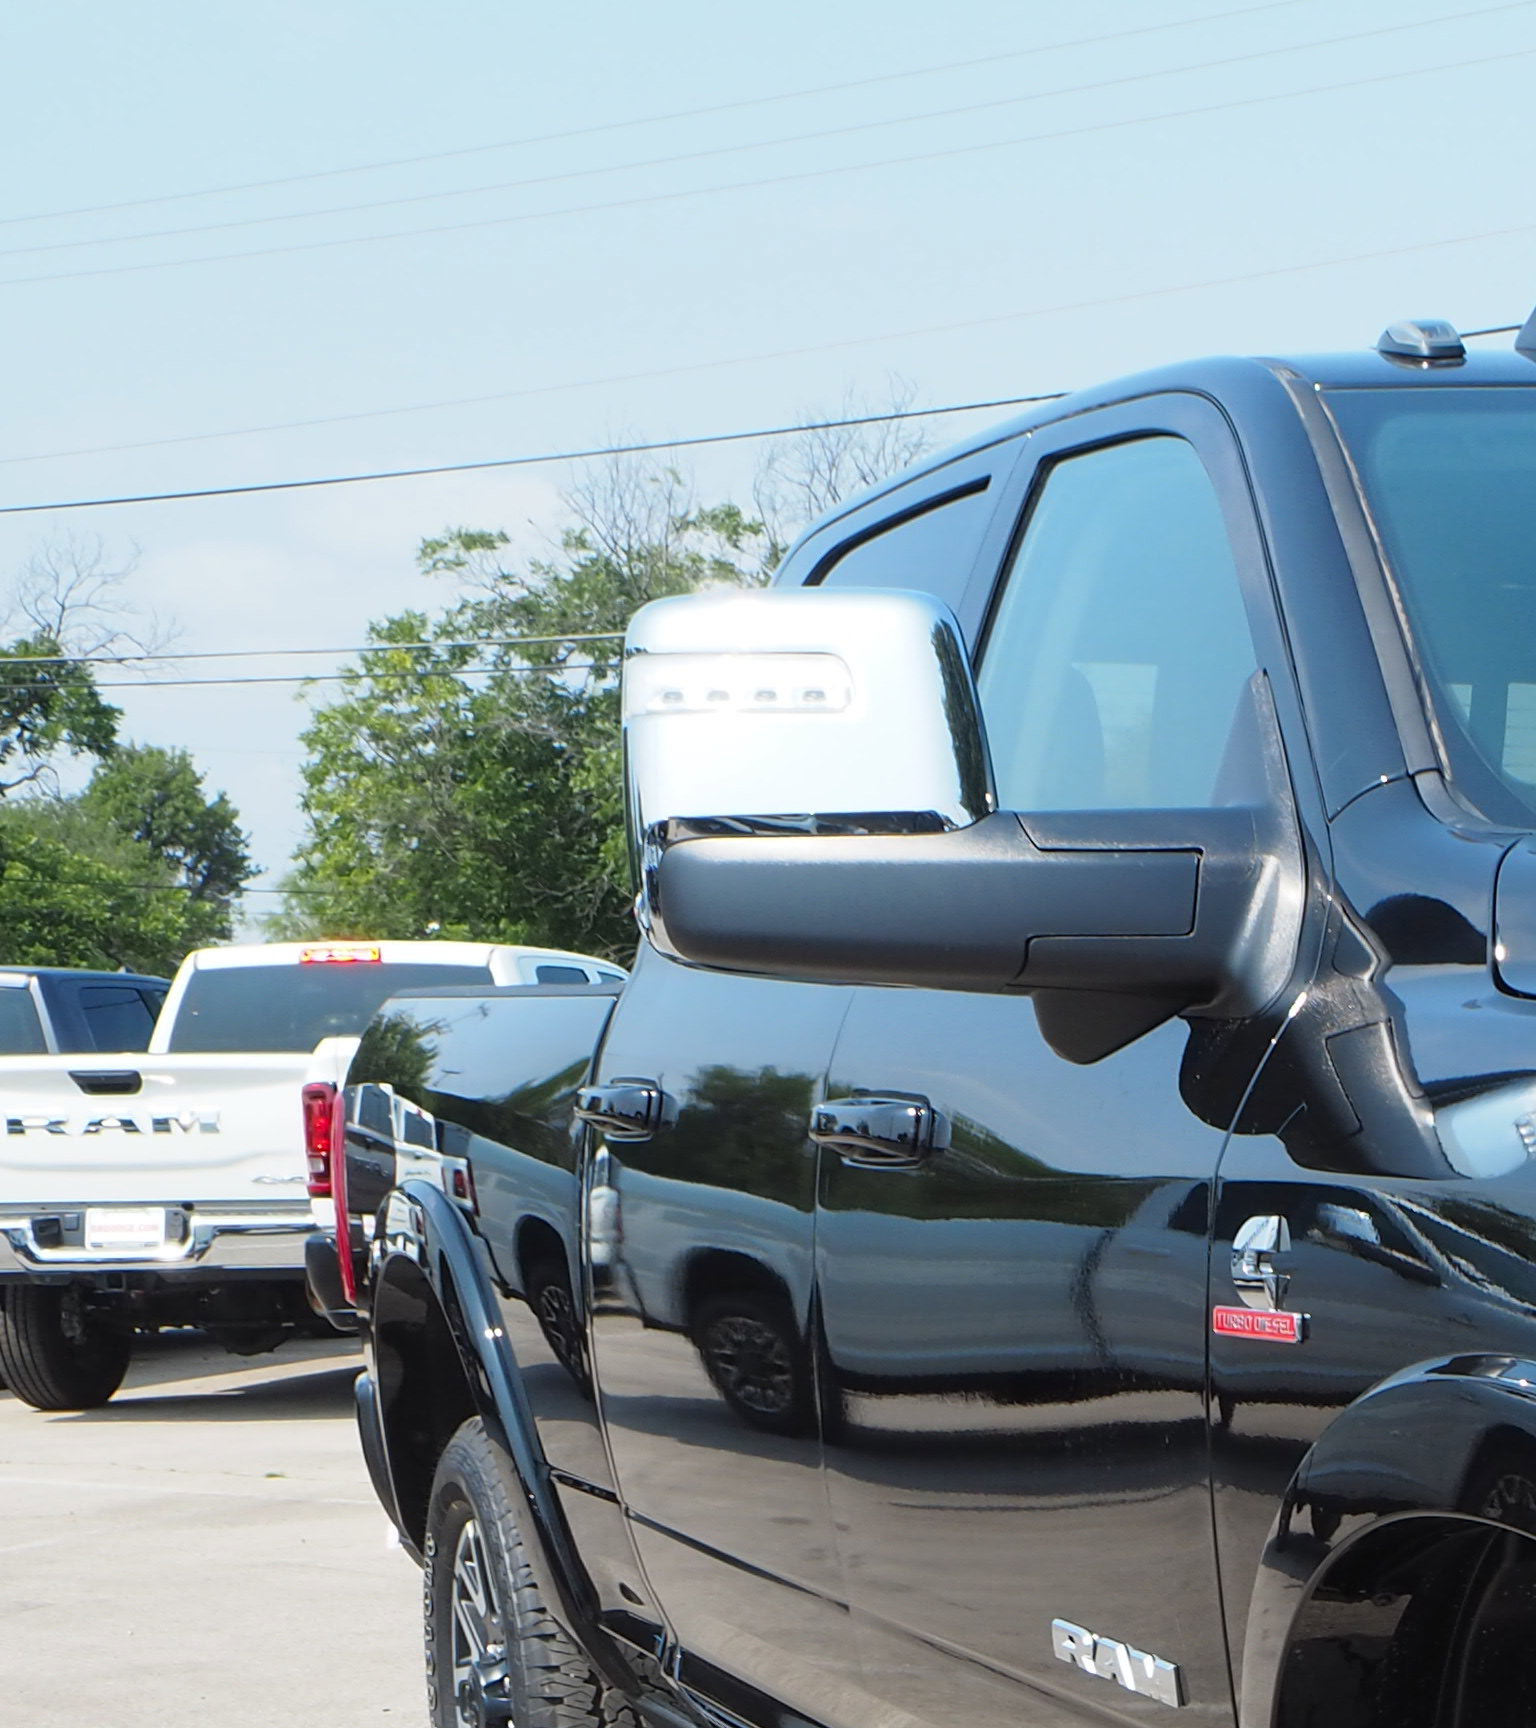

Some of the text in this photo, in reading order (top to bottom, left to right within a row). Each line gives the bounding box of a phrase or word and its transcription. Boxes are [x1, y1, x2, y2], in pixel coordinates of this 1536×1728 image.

[5, 1105, 221, 1136] RAM
[1216, 1312, 1253, 1331] TURBO
[1051, 1618, 1181, 1708] RAM
